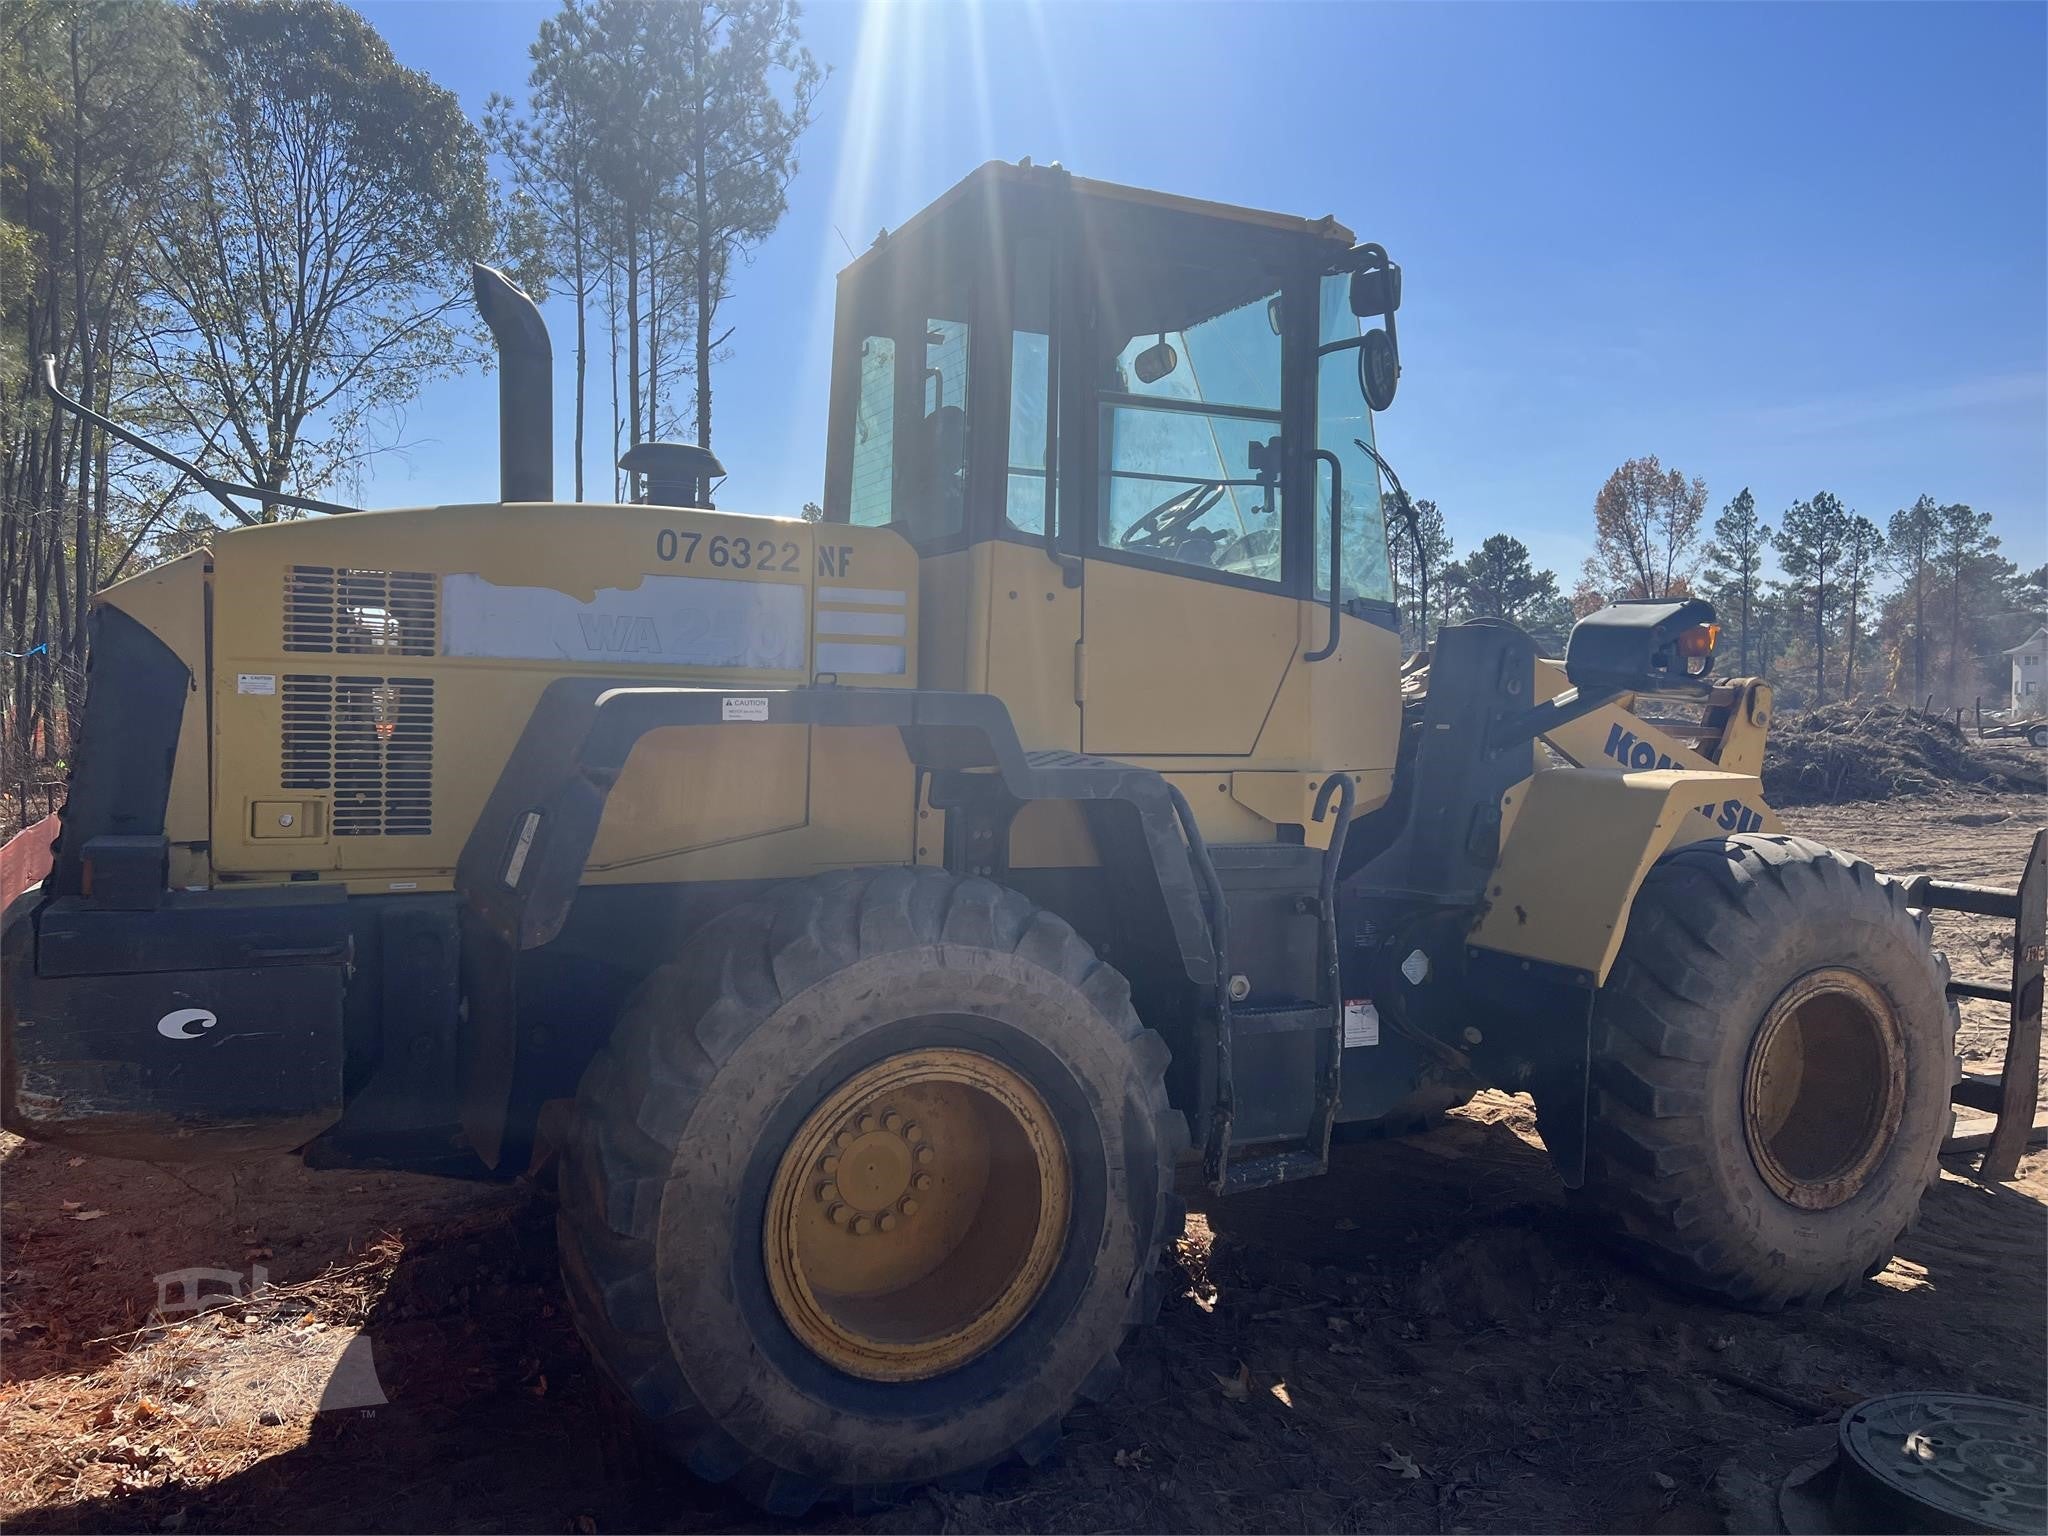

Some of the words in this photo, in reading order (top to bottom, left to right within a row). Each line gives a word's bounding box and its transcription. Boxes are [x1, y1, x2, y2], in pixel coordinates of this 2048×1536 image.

[656, 528, 800, 573] 076322
[818, 545, 854, 578] NF
[577, 613, 663, 655] WA
[1604, 722, 1764, 833] KOSU
